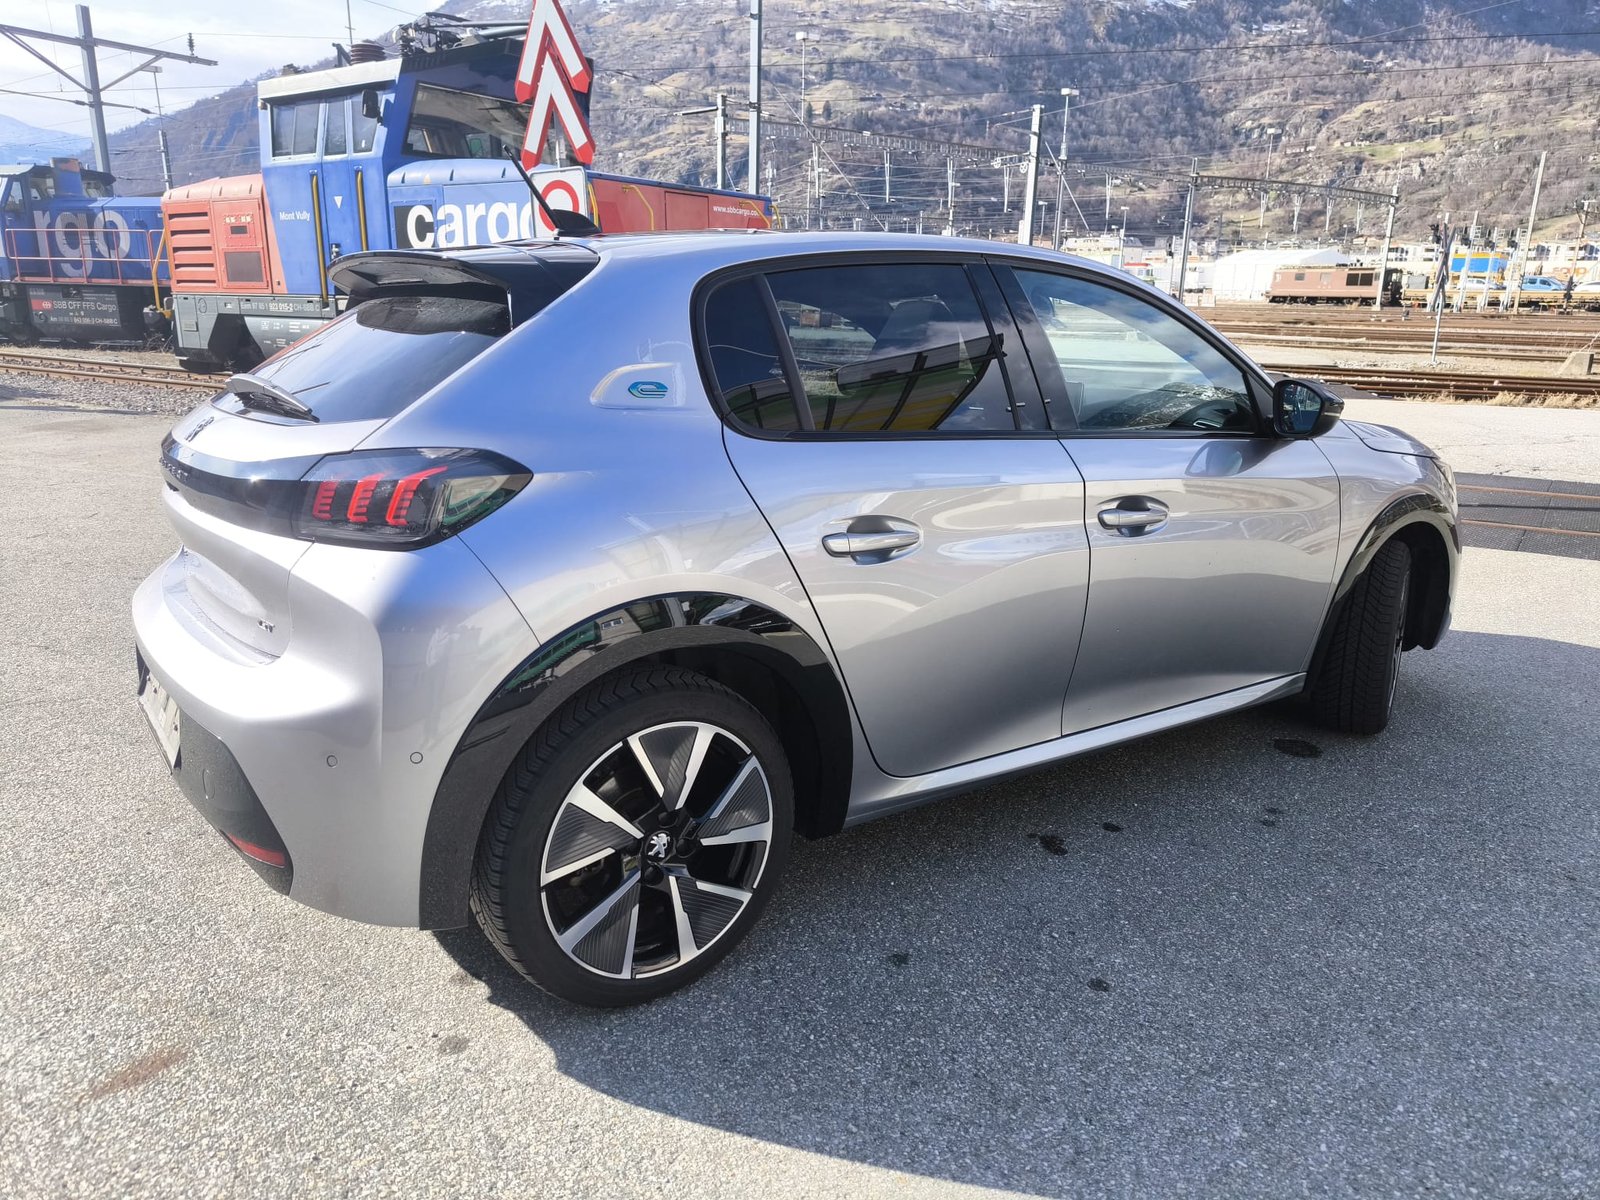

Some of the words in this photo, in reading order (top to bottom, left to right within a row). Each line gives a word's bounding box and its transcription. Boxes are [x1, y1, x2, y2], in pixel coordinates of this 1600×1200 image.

[279, 211, 295, 221] Mont
[295, 210, 311, 222] Vully
[53, 300, 67, 309] SBB
[68, 301, 81, 310] CFF
[82, 301, 95, 310] FFS
[96, 302, 117, 312] Cargo
